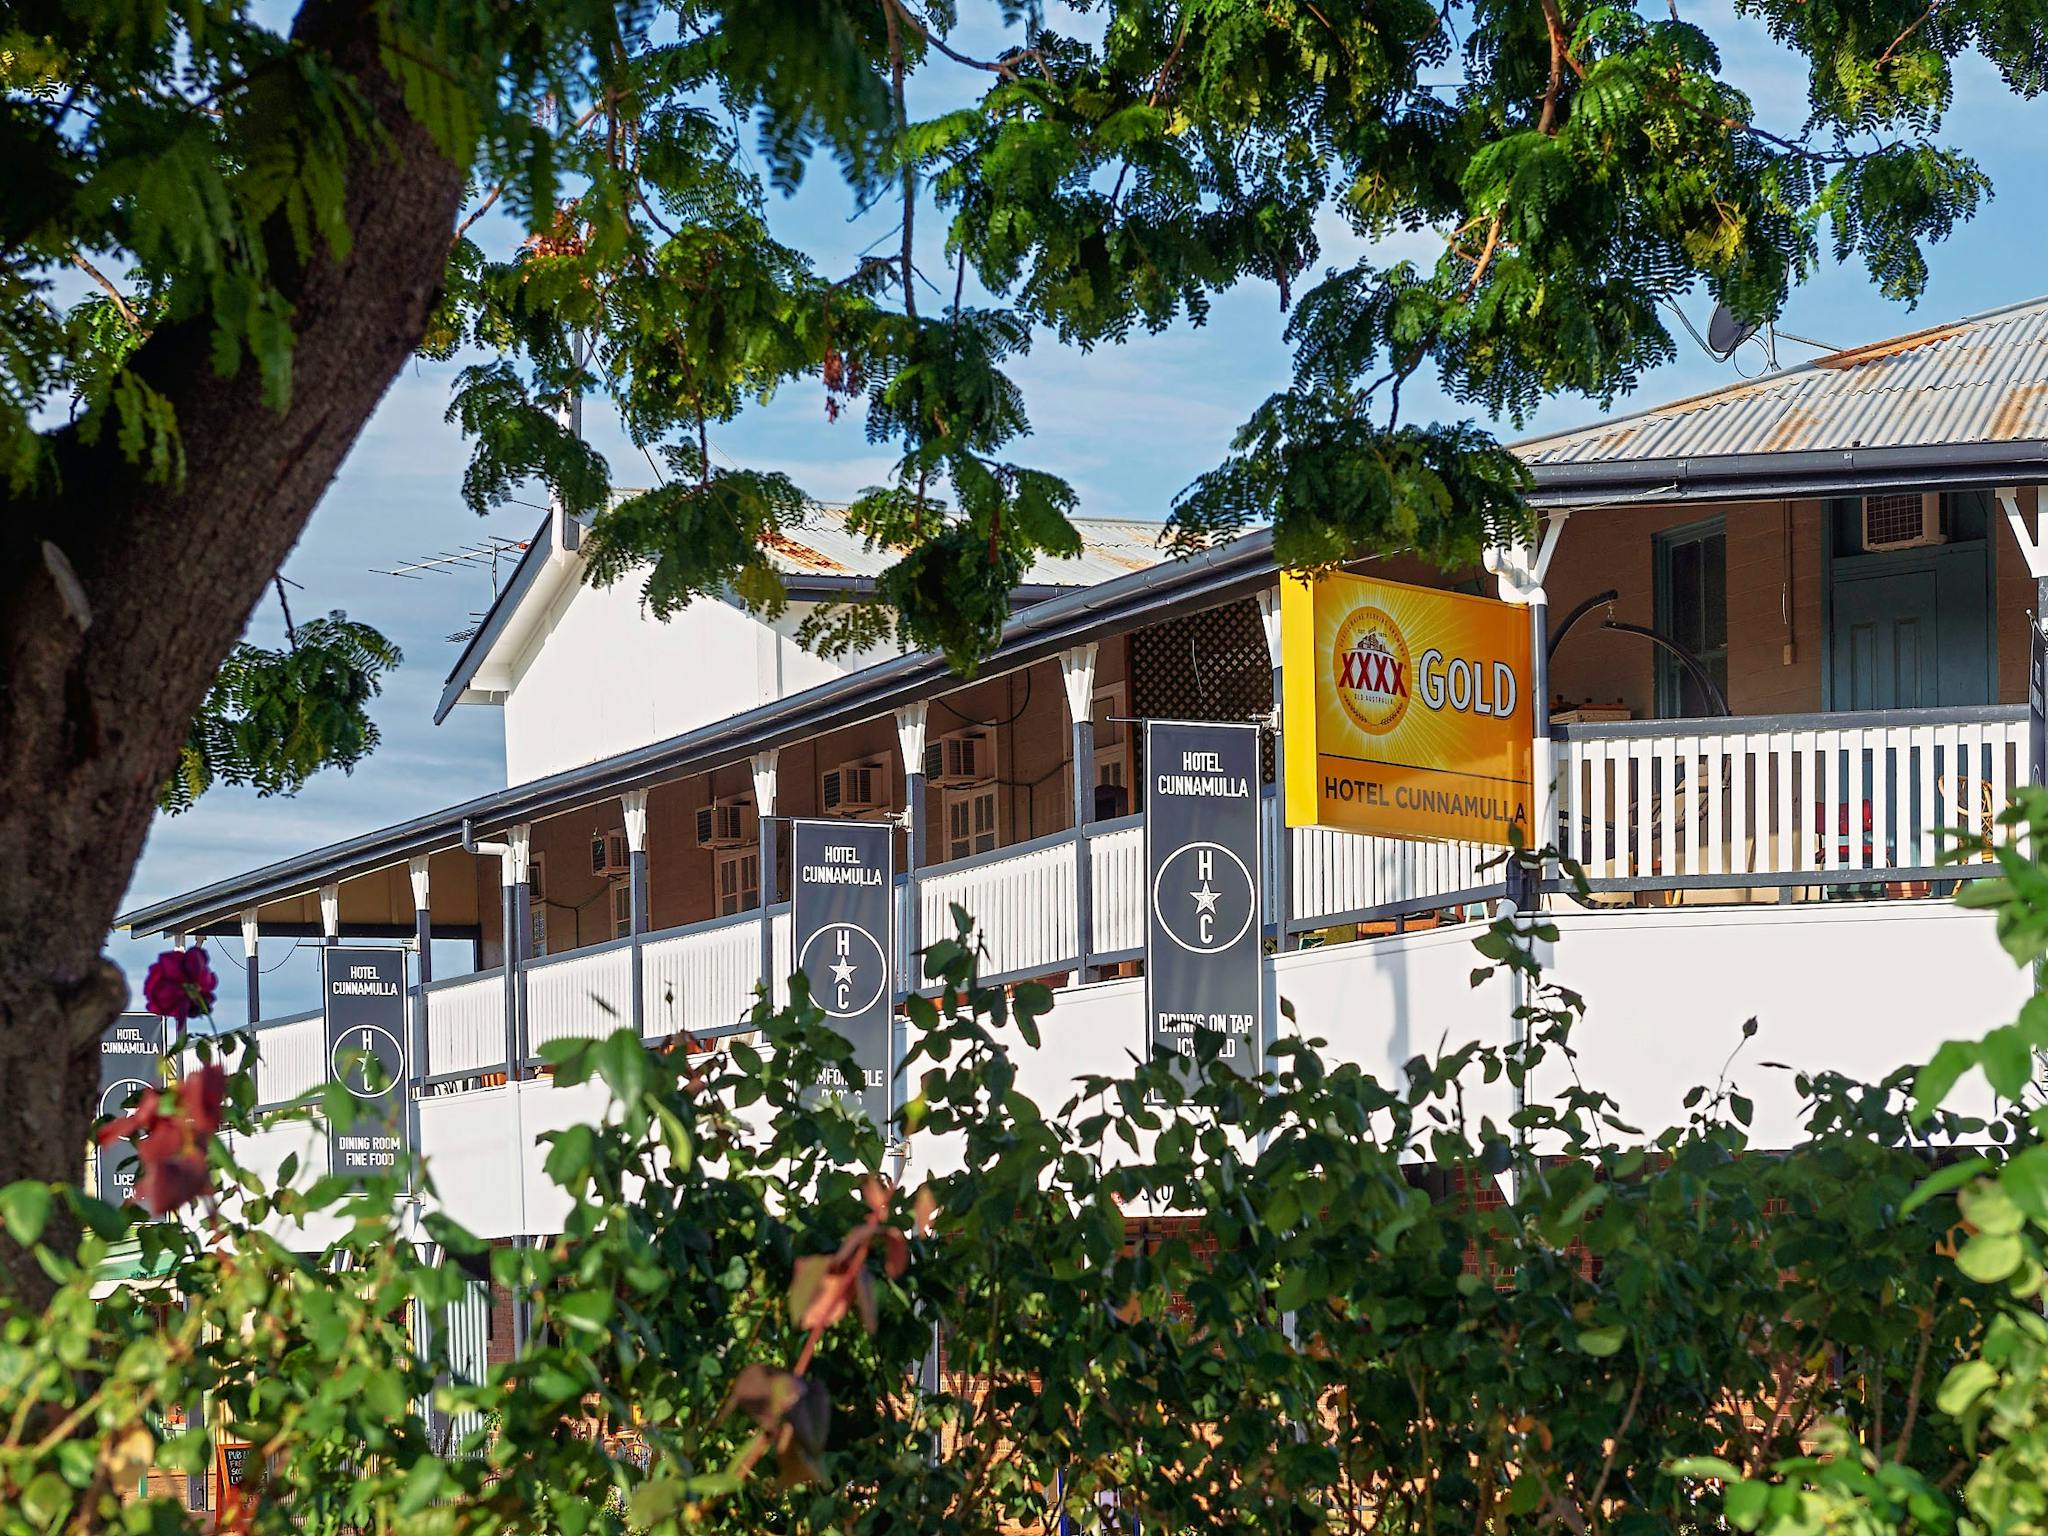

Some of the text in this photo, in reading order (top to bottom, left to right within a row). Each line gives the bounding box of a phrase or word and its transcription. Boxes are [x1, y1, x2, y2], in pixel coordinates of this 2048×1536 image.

[1338, 652, 1408, 698] XXXX
[1419, 649, 1517, 719] GOLD
[1182, 751, 1224, 773] HOTEL
[1157, 775, 1249, 798] CUNNAMULLA
[1325, 776, 1528, 824] HOTEL CUNNAMULLA
[824, 845, 861, 864] HOTEL
[1198, 850, 1213, 881] H
[802, 865, 883, 887] CUNNAMULLA
[1199, 913, 1214, 944] C
[836, 930, 850, 956] H
[350, 966, 380, 980] HOTEL
[332, 981, 399, 996] CUNNAMULLA
[837, 983, 850, 1010] C
[116, 1028, 143, 1041] HOTEL
[1159, 1013, 1254, 1034] DRINKS ON TAP
[101, 1042, 159, 1054] CUNNAMULLA
[362, 1030, 373, 1051] H
[339, 1136, 401, 1150] DINING ROOM
[346, 1153, 395, 1166] FINE FOOD
